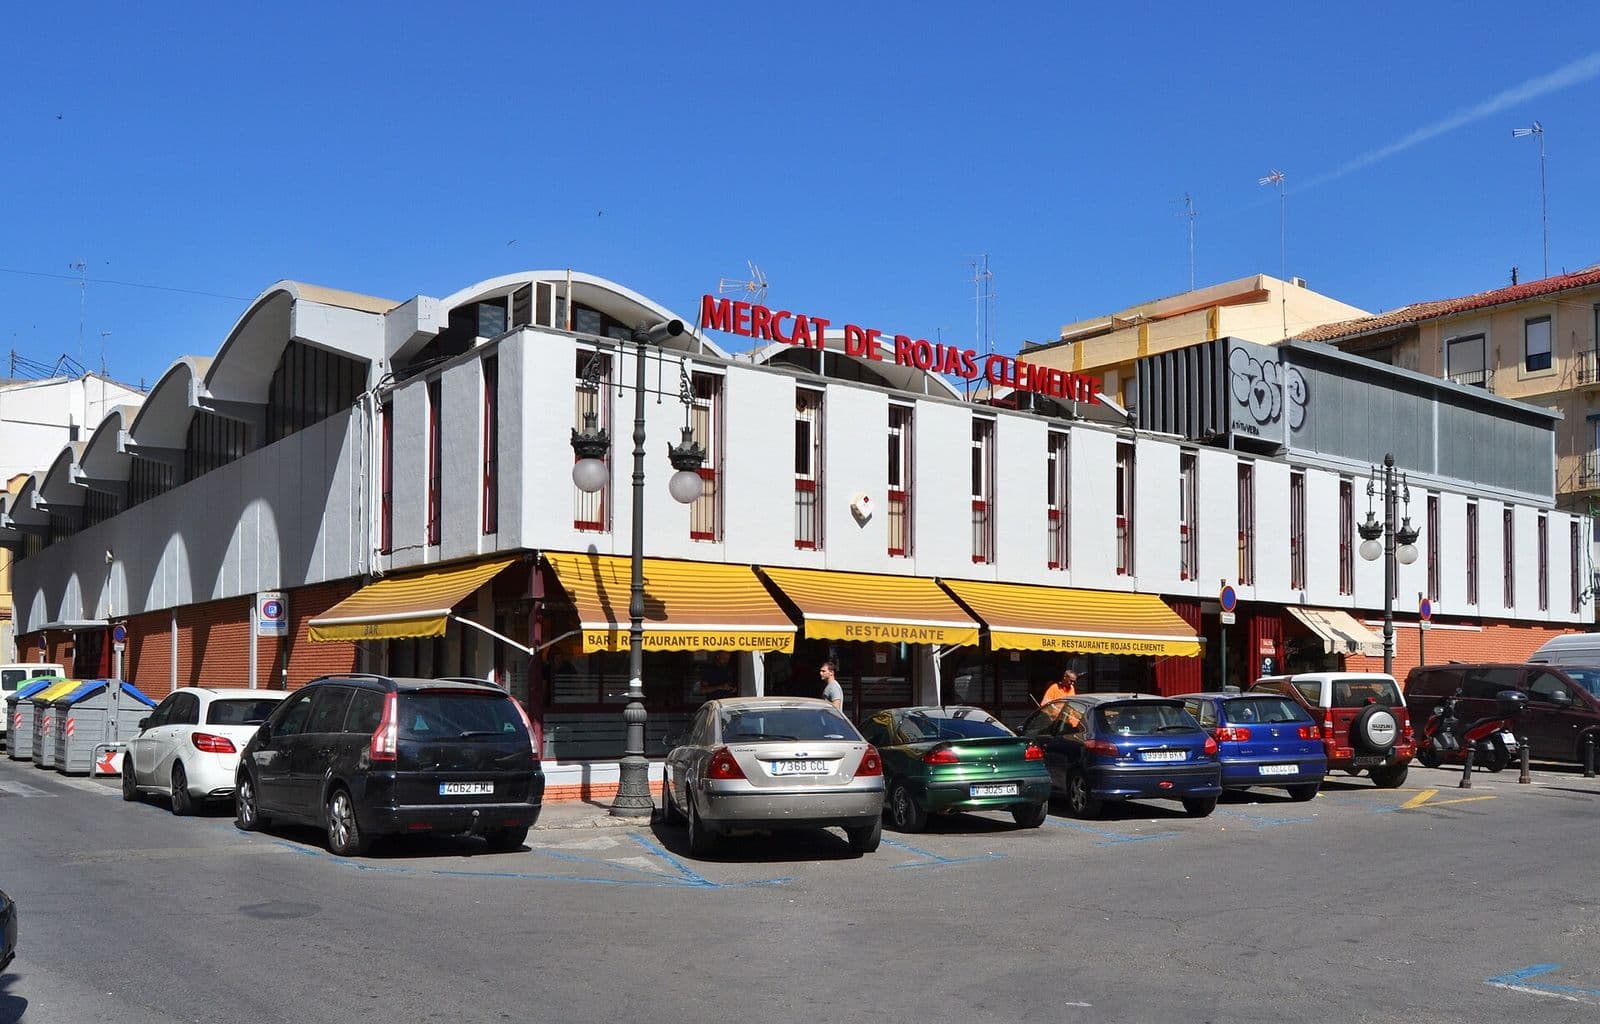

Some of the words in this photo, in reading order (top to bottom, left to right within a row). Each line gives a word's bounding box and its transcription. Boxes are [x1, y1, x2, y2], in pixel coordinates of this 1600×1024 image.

[702, 294, 830, 350] MERCAT
[844, 324, 883, 361] DE
[894, 335, 978, 379] ROJAS
[985, 354, 1101, 405] CLEMENTE
[363, 624, 380, 636] BAR
[845, 625, 945, 641] RESTAURANTE
[588, 635, 610, 646] BAR
[621, 635, 700, 647] RTAURANTE
[702, 636, 736, 648] ROJAS
[738, 637, 791, 648] CLEMENTE
[1042, 638, 1056, 648] BAR
[1061, 639, 1109, 650] RESTAURANTE
[1110, 641, 1131, 651] ROJAS
[1132, 642, 1165, 653] CLEMENTE
[780, 760, 807, 772] 7368
[809, 760, 829, 771] CCL
[447, 782, 472, 793] 4062
[474, 781, 492, 792] FML
